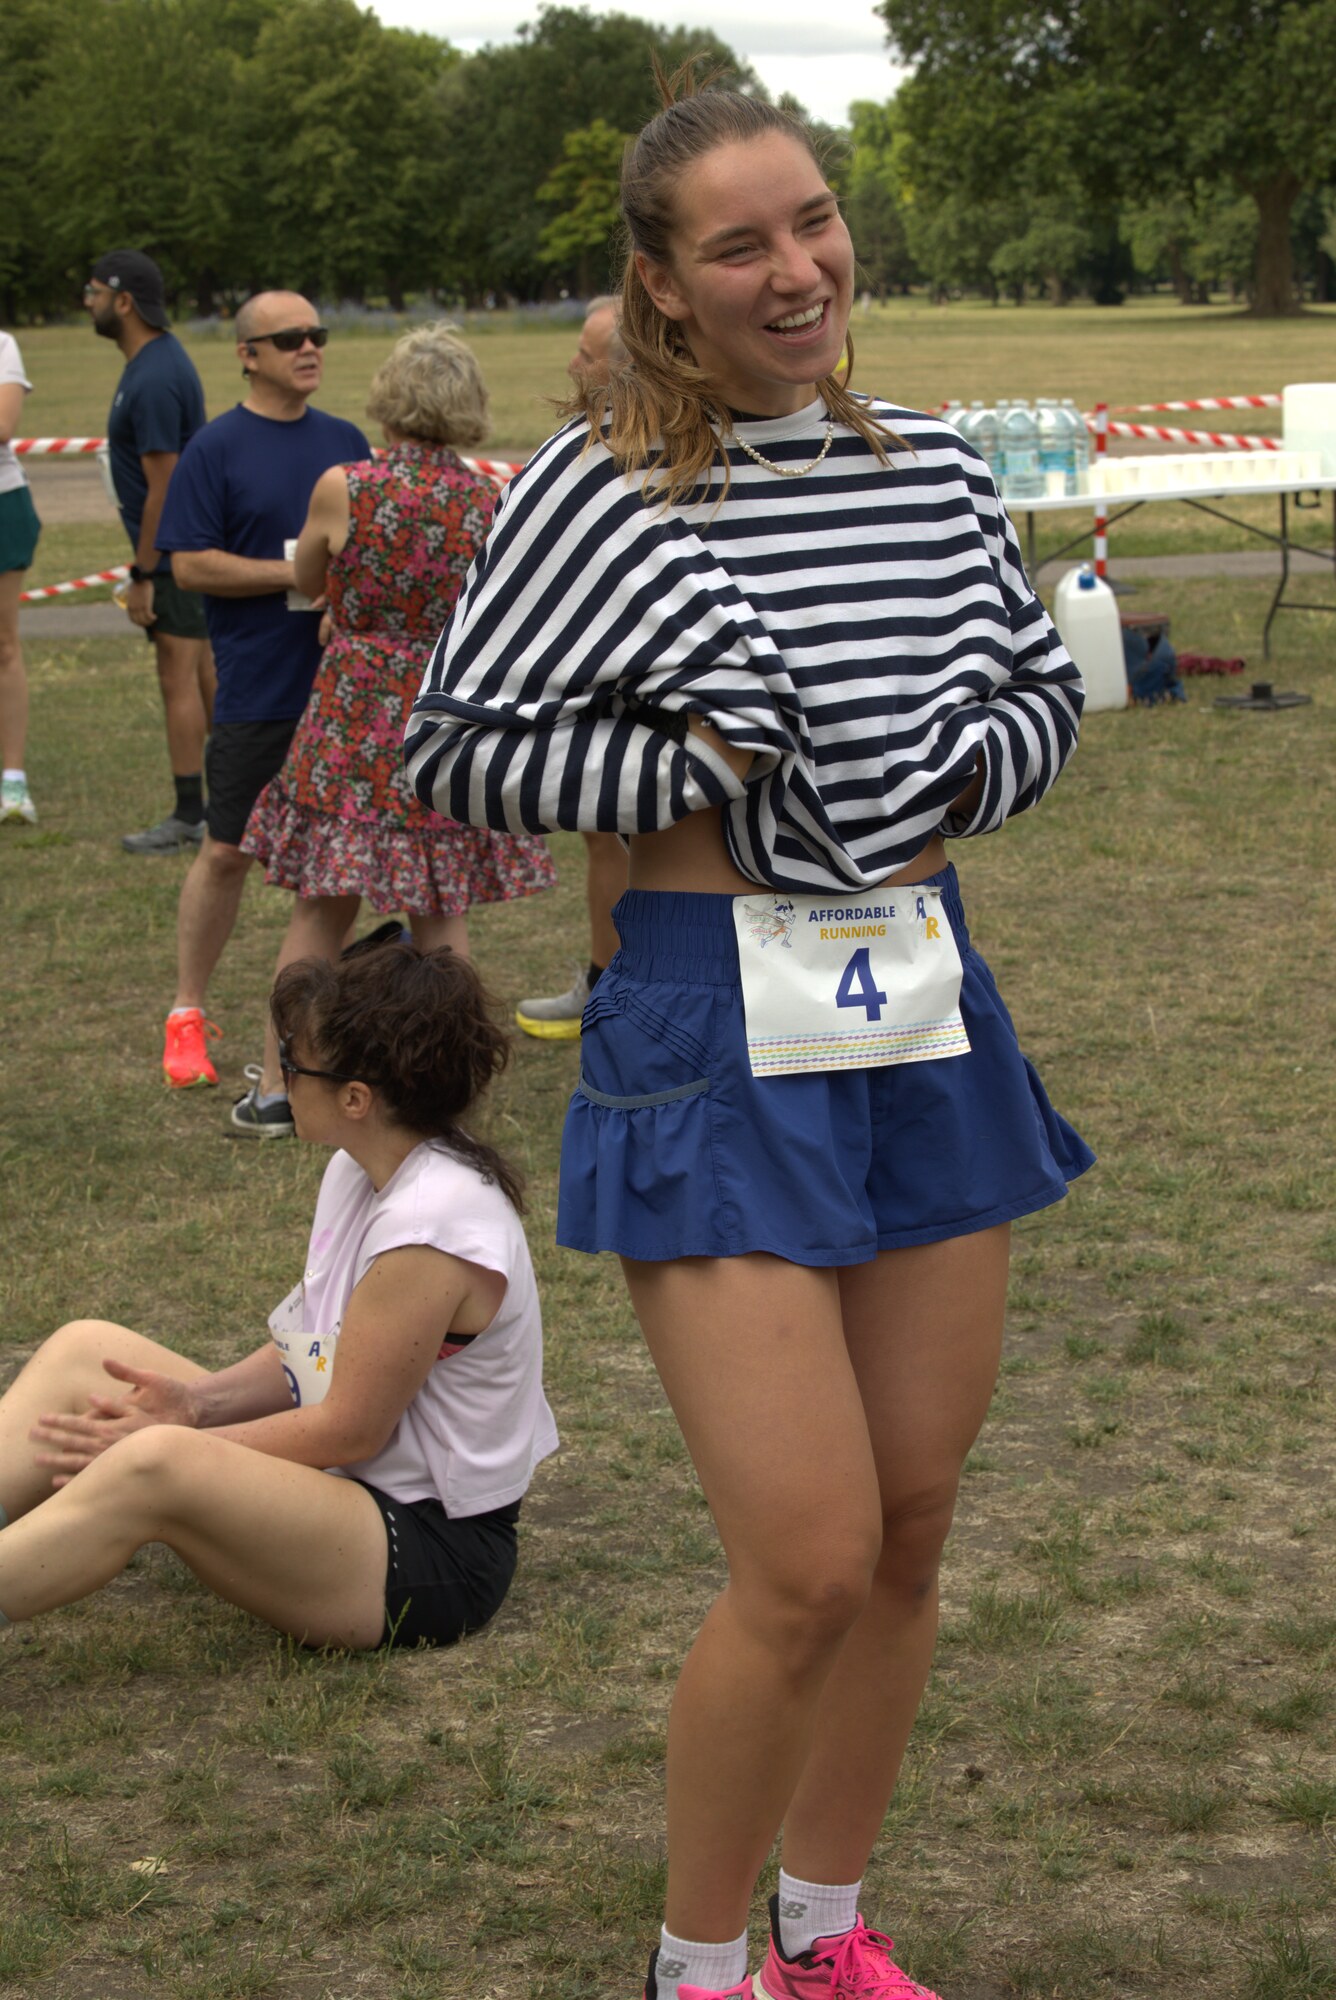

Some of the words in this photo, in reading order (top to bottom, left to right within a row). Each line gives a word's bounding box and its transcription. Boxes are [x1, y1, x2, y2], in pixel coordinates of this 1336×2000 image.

[808, 905, 896, 922] AFFORDABLE
[916, 896, 927, 920] A
[819, 925, 887, 940] RUNNING
[926, 916, 941, 940] R
[835, 947, 888, 1022] 4
[308, 1341, 320, 1357] A
[316, 1356, 327, 1372] R
